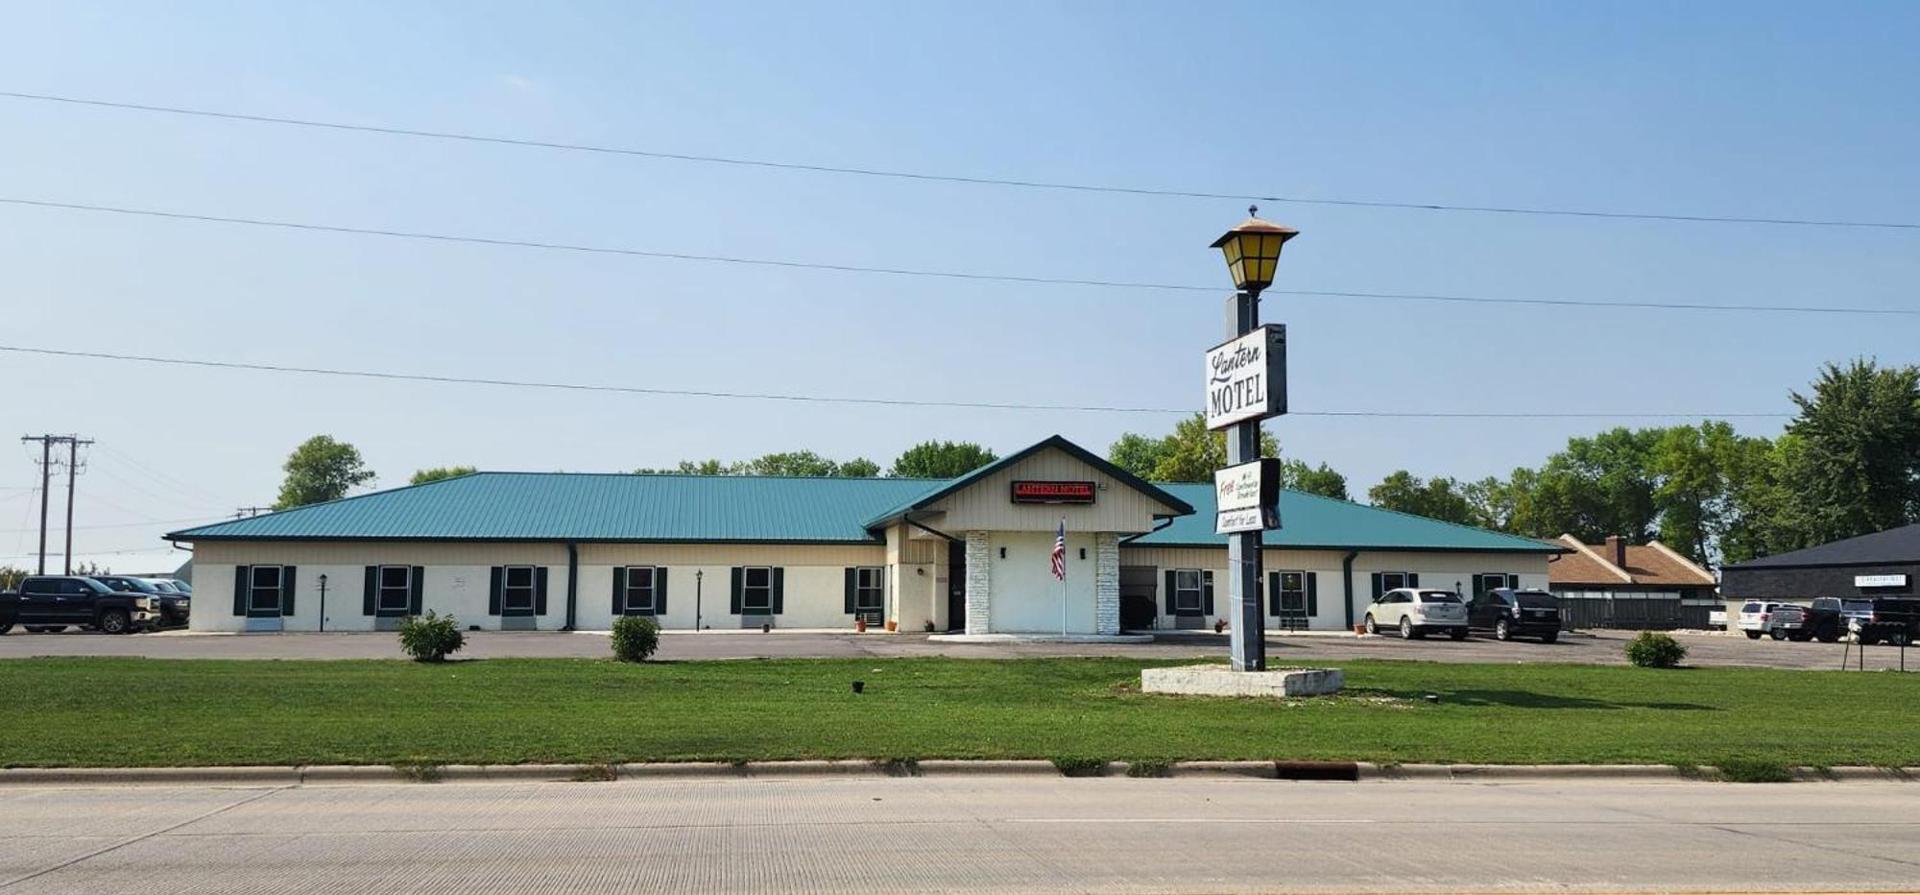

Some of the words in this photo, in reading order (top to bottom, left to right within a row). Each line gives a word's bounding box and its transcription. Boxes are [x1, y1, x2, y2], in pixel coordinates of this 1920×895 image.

[1210, 343, 1261, 385] Lantern
[1211, 373, 1264, 418] MOTEL
[1016, 484, 1058, 495] LANTERN
[1059, 484, 1091, 495] MOTEL
[1220, 479, 1236, 498] Free
